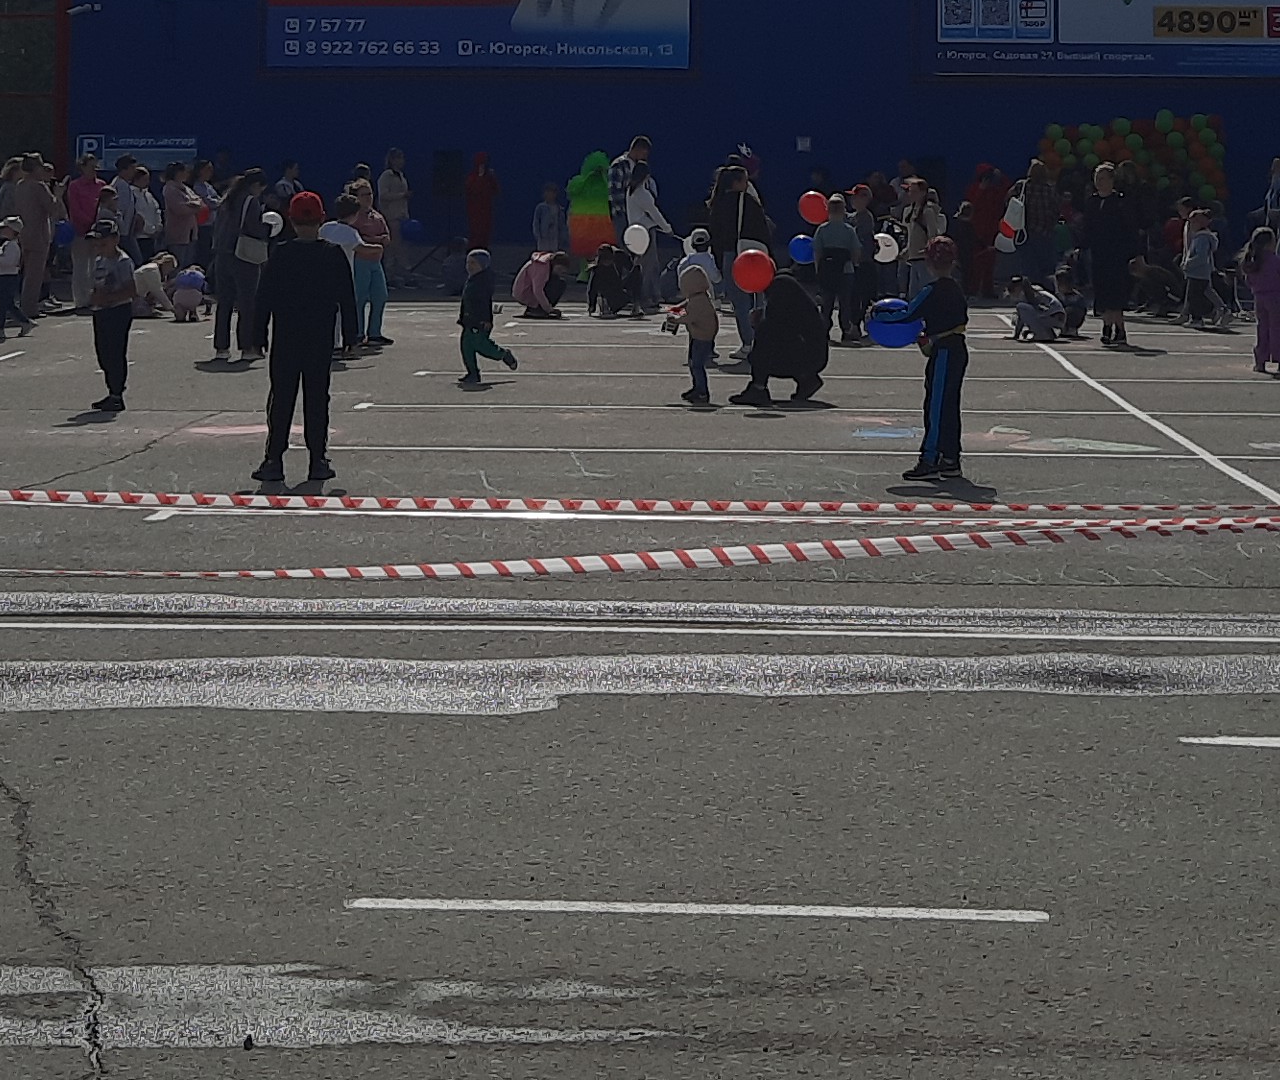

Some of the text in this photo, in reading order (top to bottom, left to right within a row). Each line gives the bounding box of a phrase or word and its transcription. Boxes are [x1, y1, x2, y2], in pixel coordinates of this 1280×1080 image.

[305, 18, 367, 33] 7 57 77
[1157, 10, 1237, 34] 4890
[305, 40, 441, 55] 8 922 762 66 33
[556, 42, 653, 57] Никольская,
[657, 43, 674, 55] 13
[82, 138, 99, 153] P
